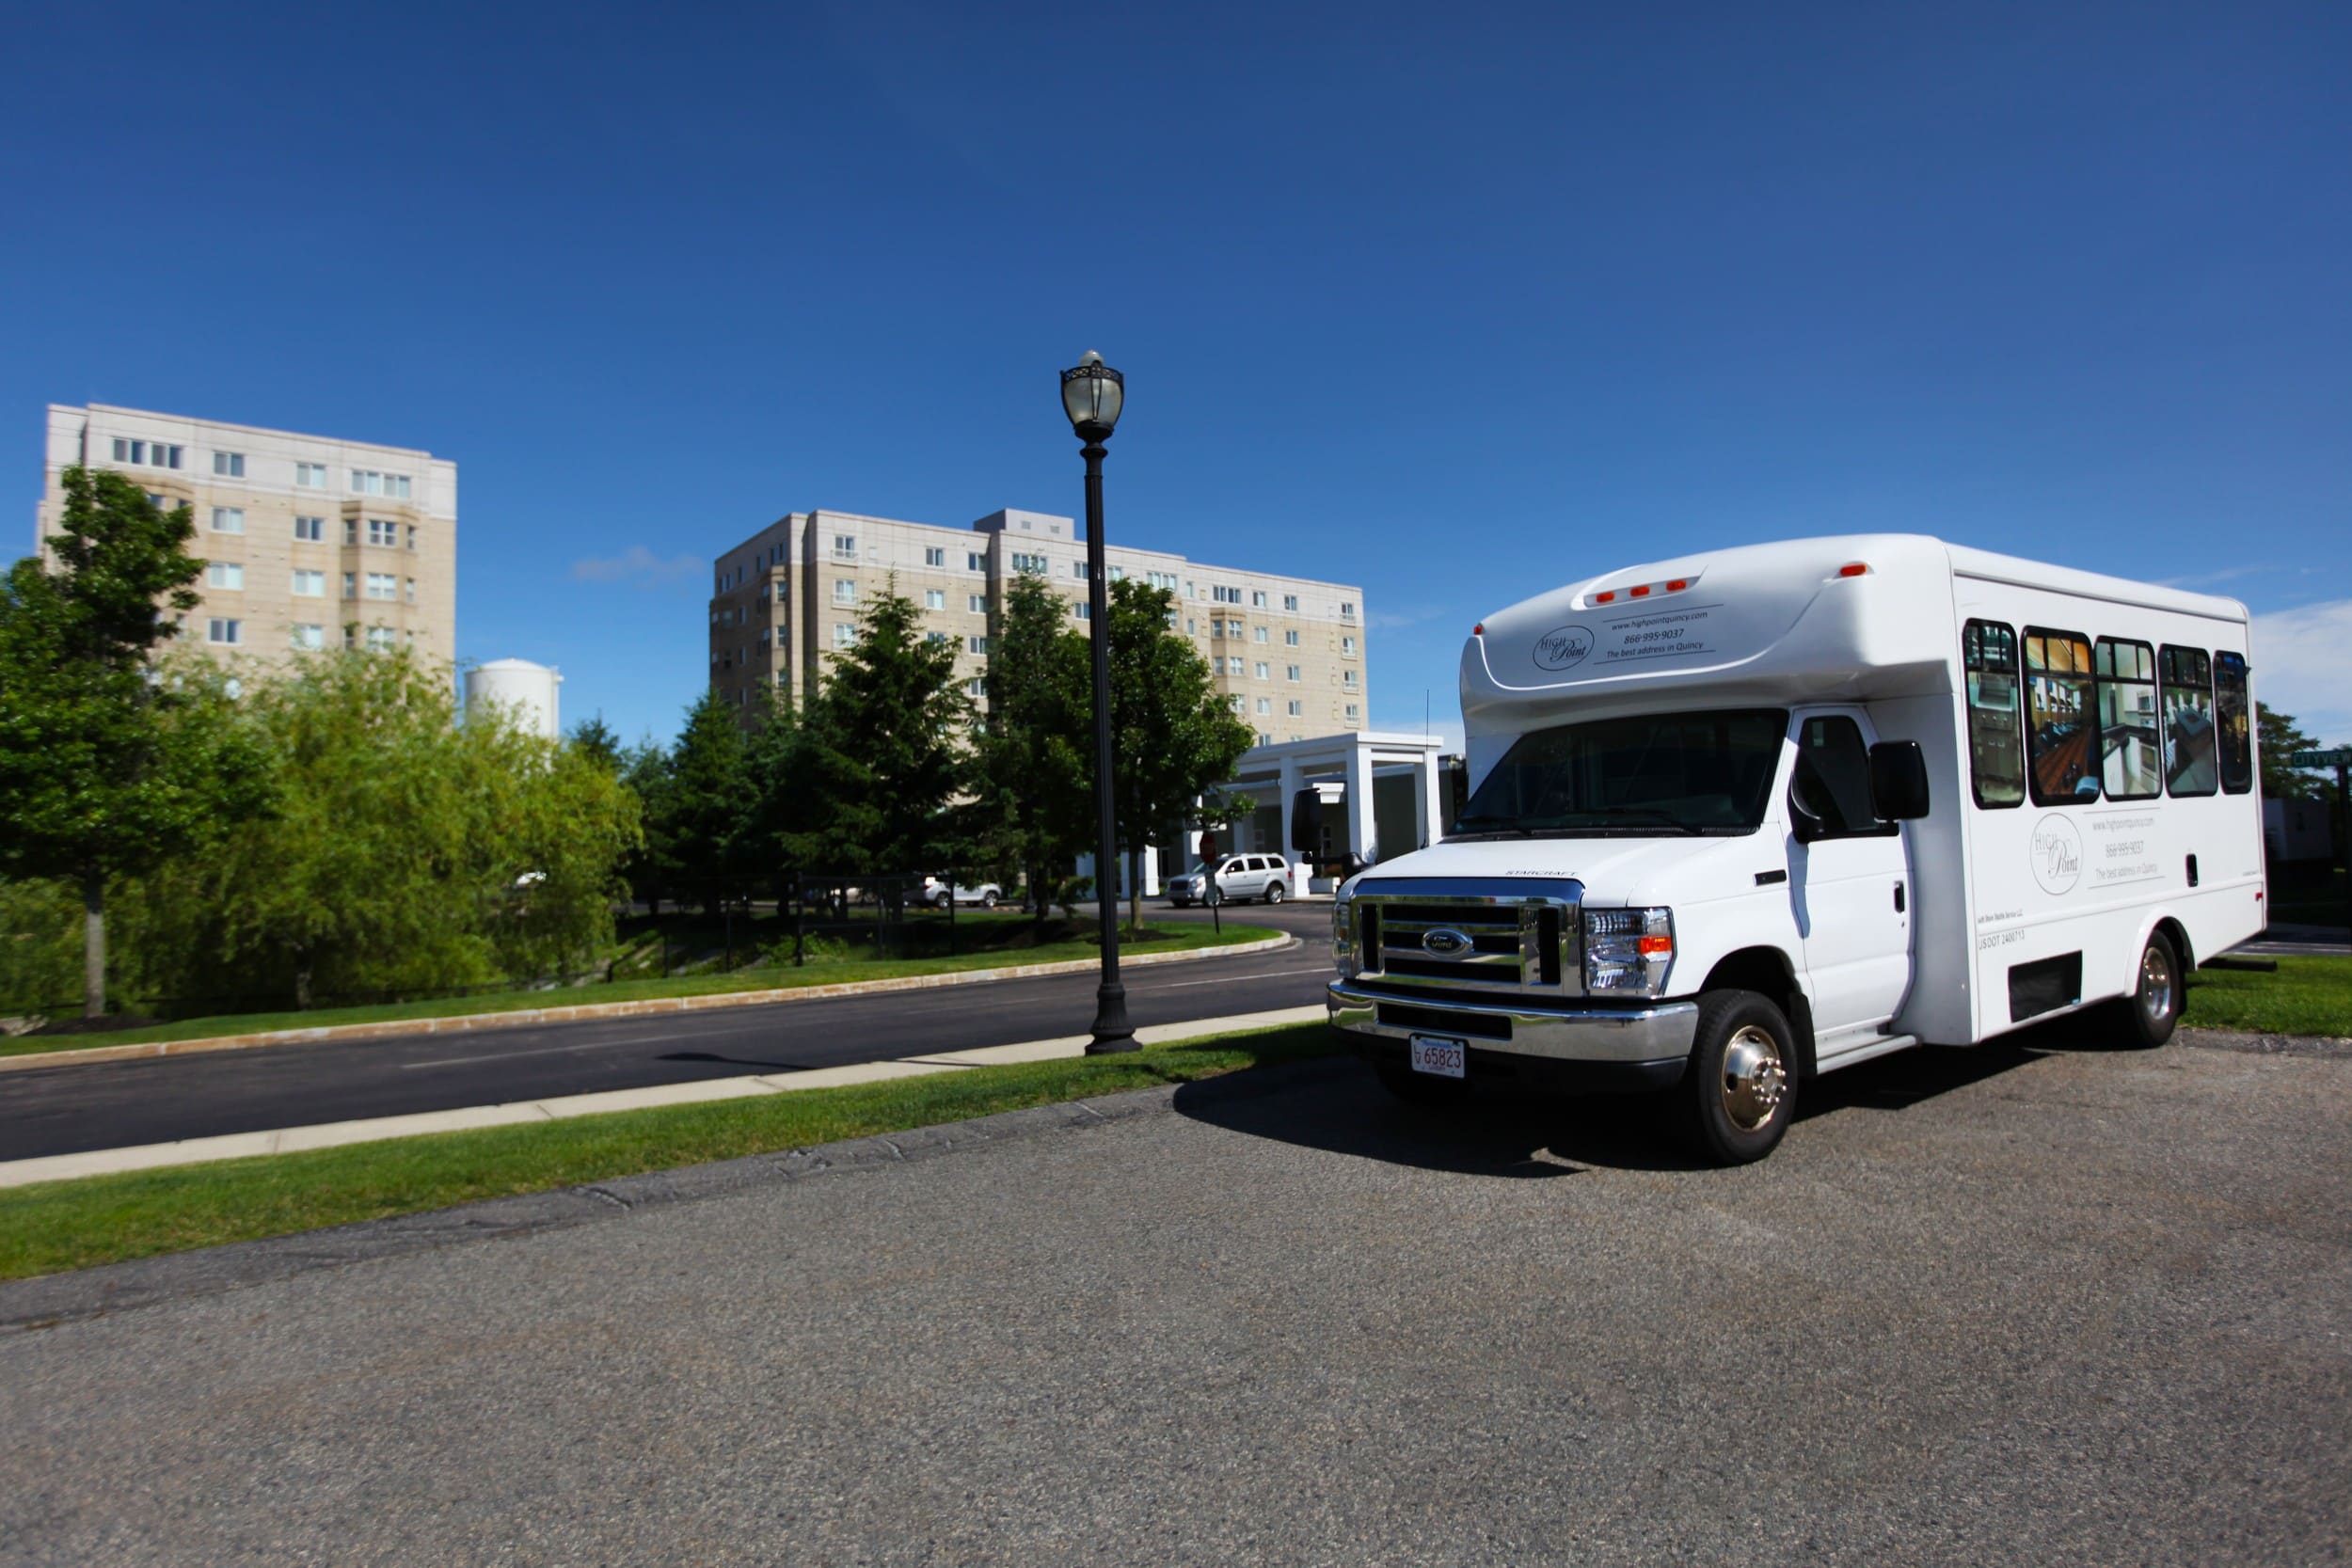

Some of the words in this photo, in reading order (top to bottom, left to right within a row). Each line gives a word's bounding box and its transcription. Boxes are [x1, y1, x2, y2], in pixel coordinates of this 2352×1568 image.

[1612, 611, 1708, 631] www.highpointquincy.com
[1540, 637, 1566, 649] HIGH
[1550, 639, 1587, 662] Point
[1607, 650, 1619, 658] The
[1621, 648, 1636, 657] best
[1638, 645, 1665, 655] address
[1677, 641, 1704, 651] Quincy
[2048, 839, 2078, 879] Point
[2095, 867, 2106, 880] The
[1432, 936, 1454, 948] Ford
[1424, 1047, 1461, 1069] 65823
